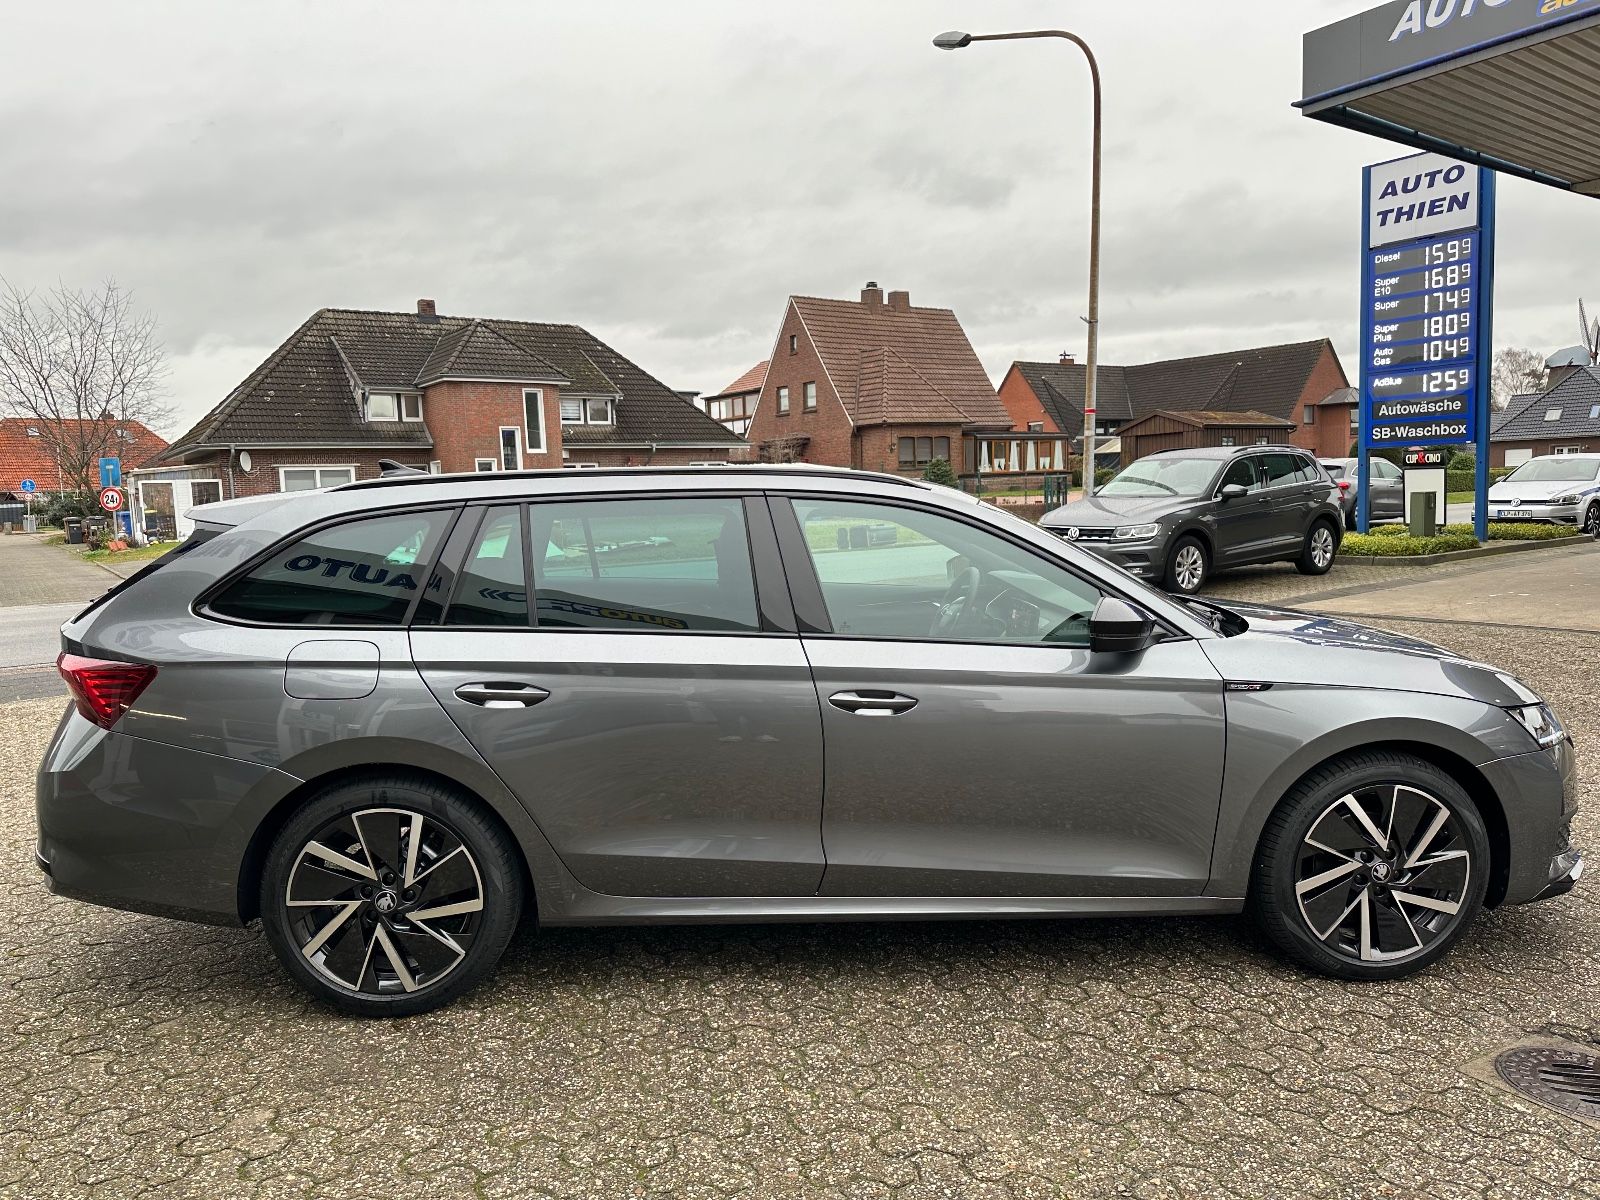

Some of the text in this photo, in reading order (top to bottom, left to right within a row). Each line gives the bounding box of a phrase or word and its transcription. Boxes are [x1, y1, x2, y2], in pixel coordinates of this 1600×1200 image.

[1378, 164, 1466, 200] AUTO
[1376, 191, 1470, 227] THIEN
[1374, 251, 1401, 264] Diesel
[1374, 277, 1400, 288] Super
[1374, 287, 1391, 297] E10
[1374, 301, 1400, 311] Super
[1373, 324, 1399, 334] Super
[1373, 334, 1392, 343] Plus
[1373, 348, 1394, 357] Auto
[1373, 357, 1391, 366] Gas
[1373, 377, 1403, 388] AdBlue
[1378, 400, 1462, 417] Autowäsche
[1372, 424, 1467, 440] SB-Waschbox
